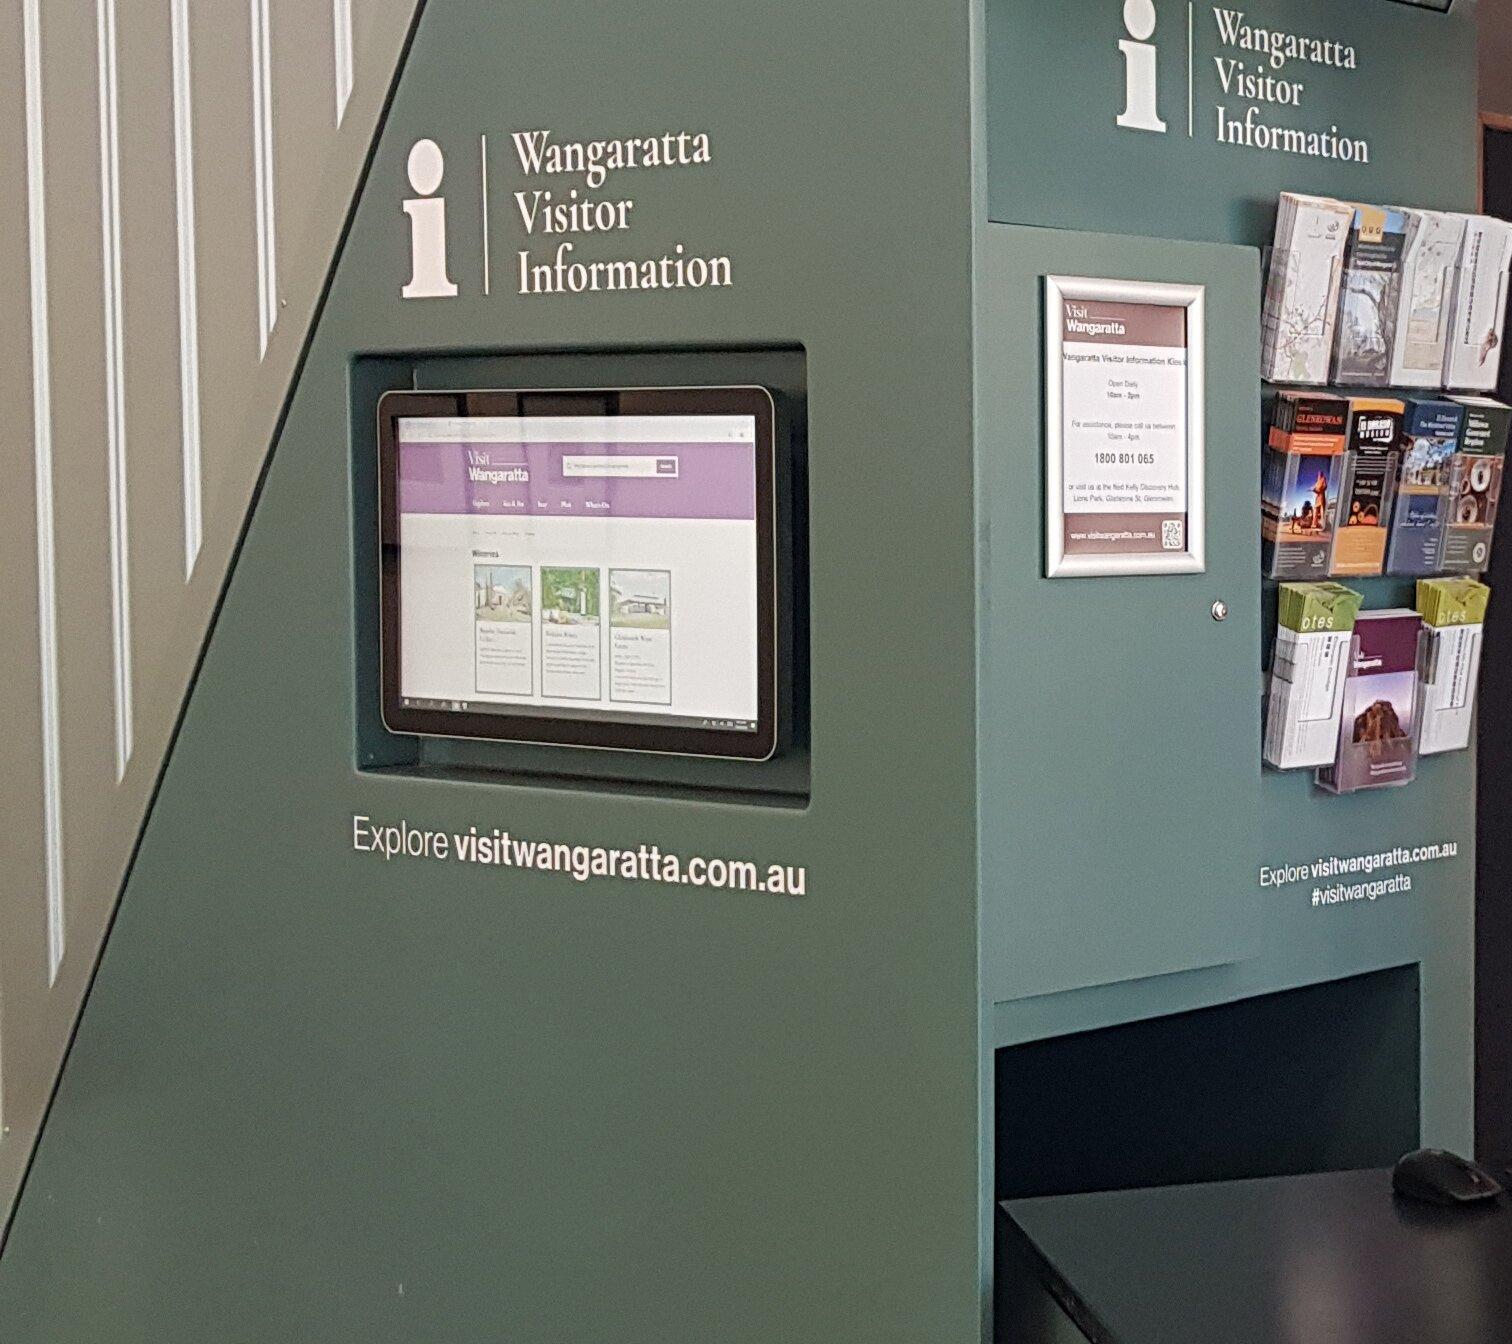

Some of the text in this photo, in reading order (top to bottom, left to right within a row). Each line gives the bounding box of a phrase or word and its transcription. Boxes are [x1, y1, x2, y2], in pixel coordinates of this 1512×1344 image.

[1212, 7, 1357, 69] Wangaratta
[1214, 56, 1304, 106] Visitor
[1216, 106, 1369, 163] Information
[512, 130, 712, 189] Wangaratta
[513, 189, 633, 234] Visitor
[517, 243, 733, 294] Information
[1066, 305, 1088, 318] Visit
[1066, 319, 1126, 336] Wangaratta
[468, 466, 530, 484] Wangaratta
[1095, 453, 1115, 463] 1800
[1119, 453, 1135, 463] 801
[353, 815, 807, 896] Explore visitwangaratta.com.au
[1260, 841, 1458, 887] Explore visitwangaratta.com.au
[1311, 874, 1412, 906] #visitwangaratta
